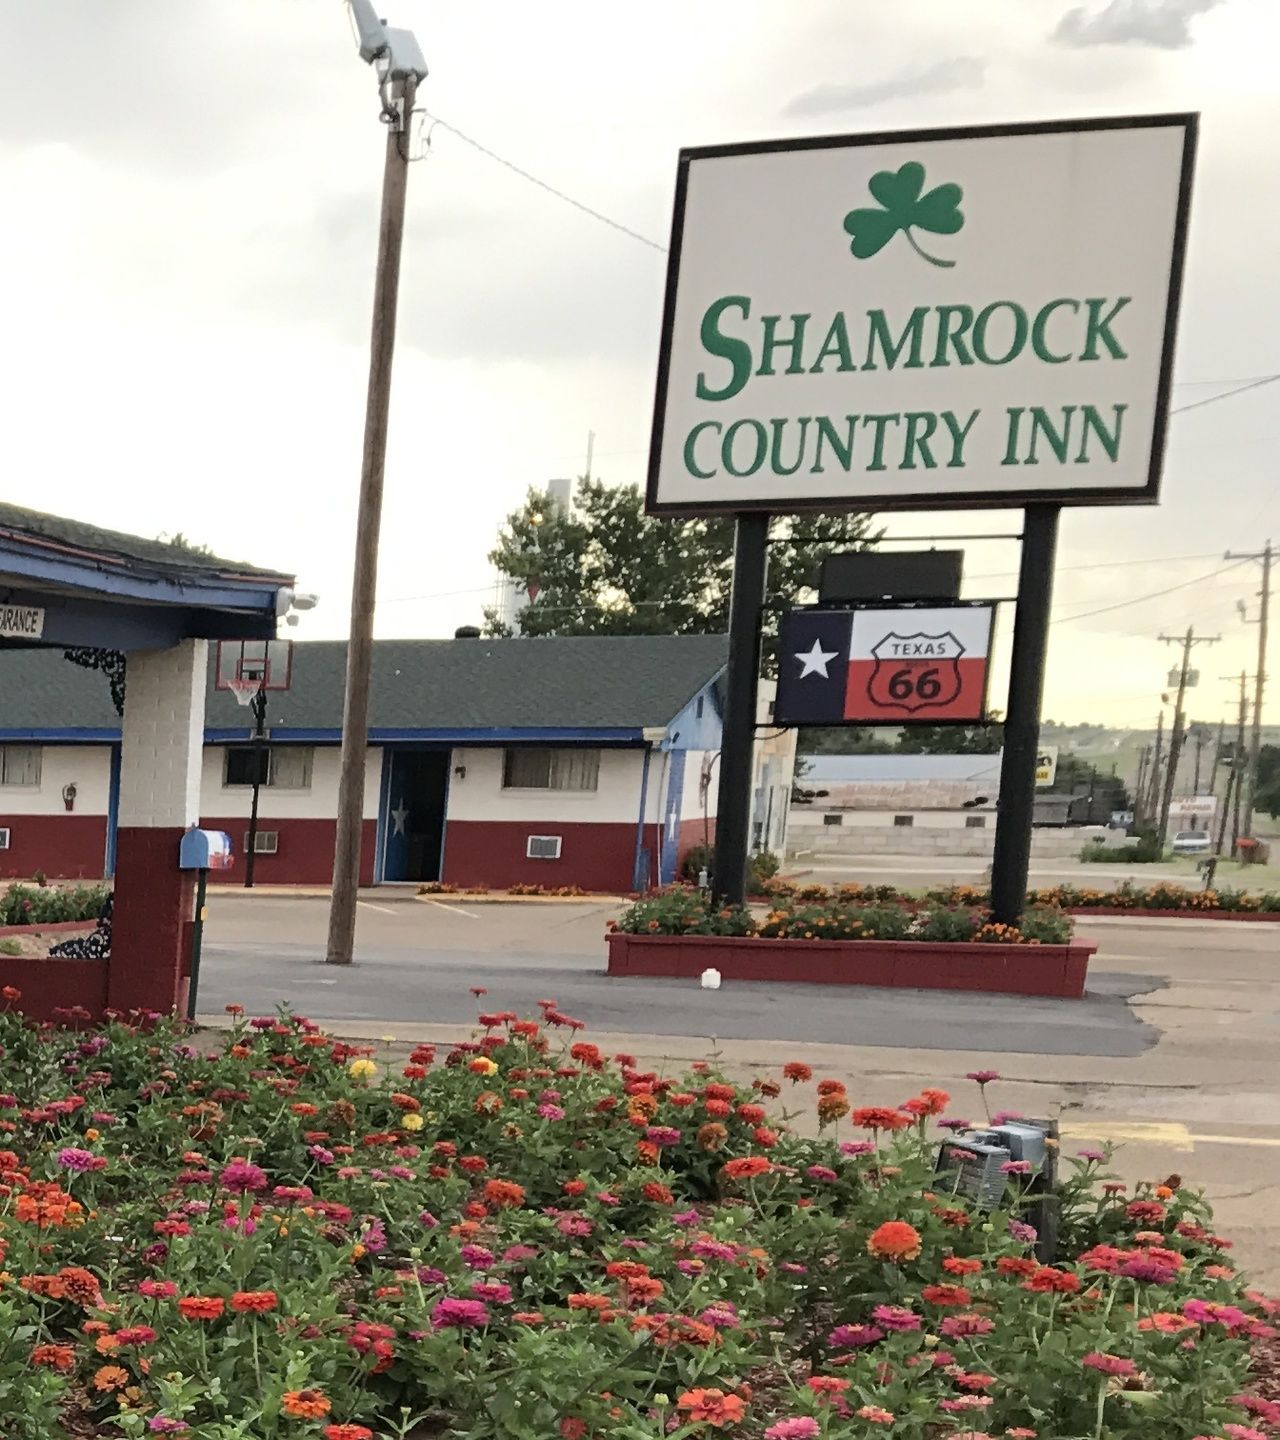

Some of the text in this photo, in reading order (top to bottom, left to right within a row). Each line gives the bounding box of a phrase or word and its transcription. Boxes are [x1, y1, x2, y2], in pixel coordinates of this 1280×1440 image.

[695, 295, 1132, 401] SHAMROCK
[683, 404, 1128, 479] COUNTRY INN
[891, 642, 946, 655] TEXAS
[888, 667, 941, 699] 66
